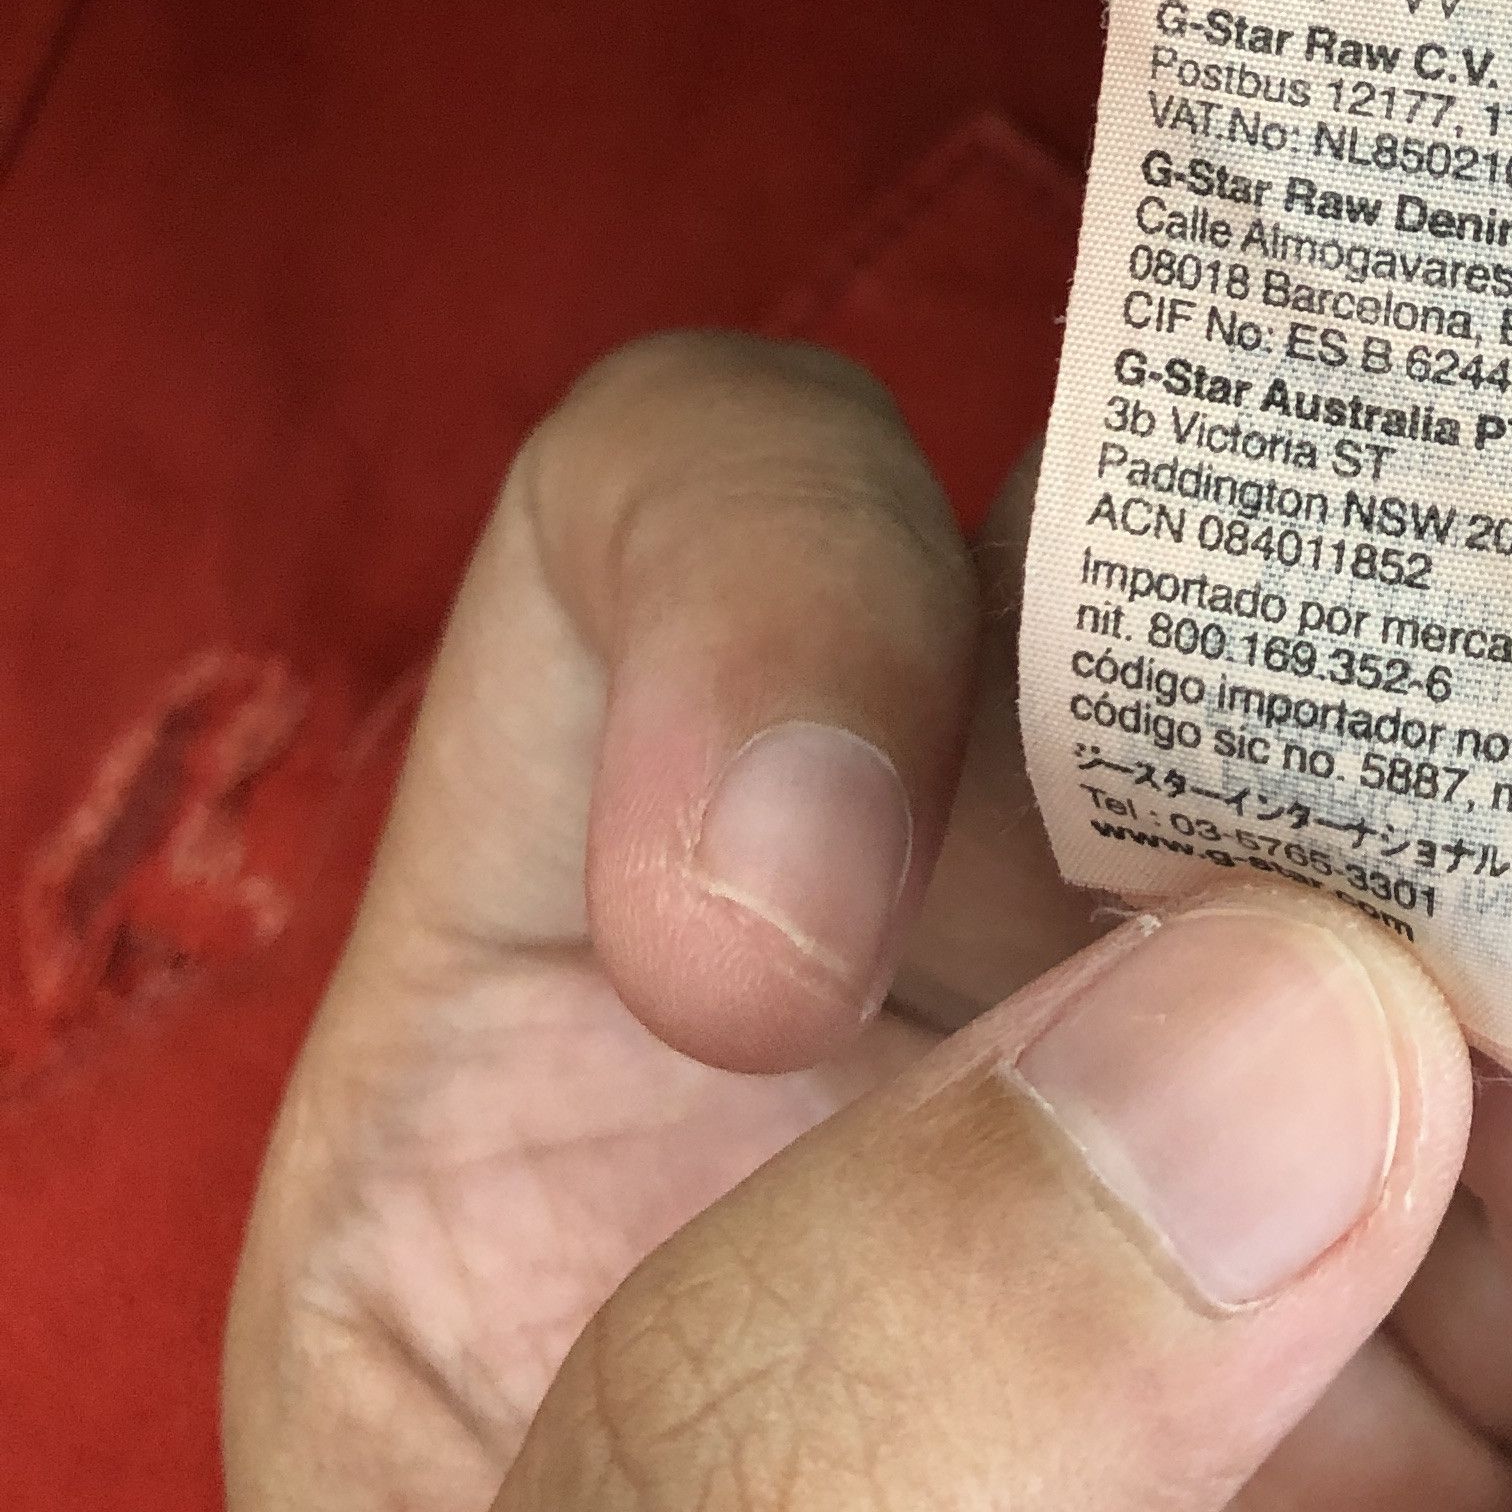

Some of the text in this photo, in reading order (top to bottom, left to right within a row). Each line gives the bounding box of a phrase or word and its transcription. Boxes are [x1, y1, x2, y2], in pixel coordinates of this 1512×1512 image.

[1150, 46, 1310, 108] Postbus
[1329, 78, 1463, 138] 12177,
[1156, 0, 1294, 57] G-Star
[1305, 26, 1401, 74] Raw
[1414, 42, 1498, 87] C.V.
[1136, 195, 1231, 249] Calle
[1141, 149, 1272, 207] G-Star
[1284, 177, 1382, 227] Raw
[1123, 291, 1197, 334] CIF
[1206, 307, 1274, 355] No:
[1284, 321, 1348, 368] ES
[1361, 337, 1395, 376] B
[1129, 243, 1250, 300] 08018
[1263, 268, 1484, 347] Barcelona,
[1104, 395, 1397, 482] 3b Victoria ST
[1114, 347, 1253, 409] G-Star
[1260, 377, 1461, 448] Australia
[1087, 491, 1434, 591] ACN 084011852
[1096, 441, 1328, 526] Paddington
[1343, 490, 1457, 545] NSW
[1080, 545, 1287, 623] Importado
[1300, 600, 1366, 639] por
[1071, 647, 1202, 707] código
[1216, 673, 1446, 754] importador
[1076, 600, 1453, 703] nit. 800.169.352-6
[1069, 691, 1201, 750] código
[1214, 727, 1270, 765] sic
[1283, 744, 1345, 782] no.
[1359, 752, 1476, 813] 5887,
[1090, 818, 1415, 943] www.g-starcom
[1170, 812, 1436, 918] 03-5765-3301
